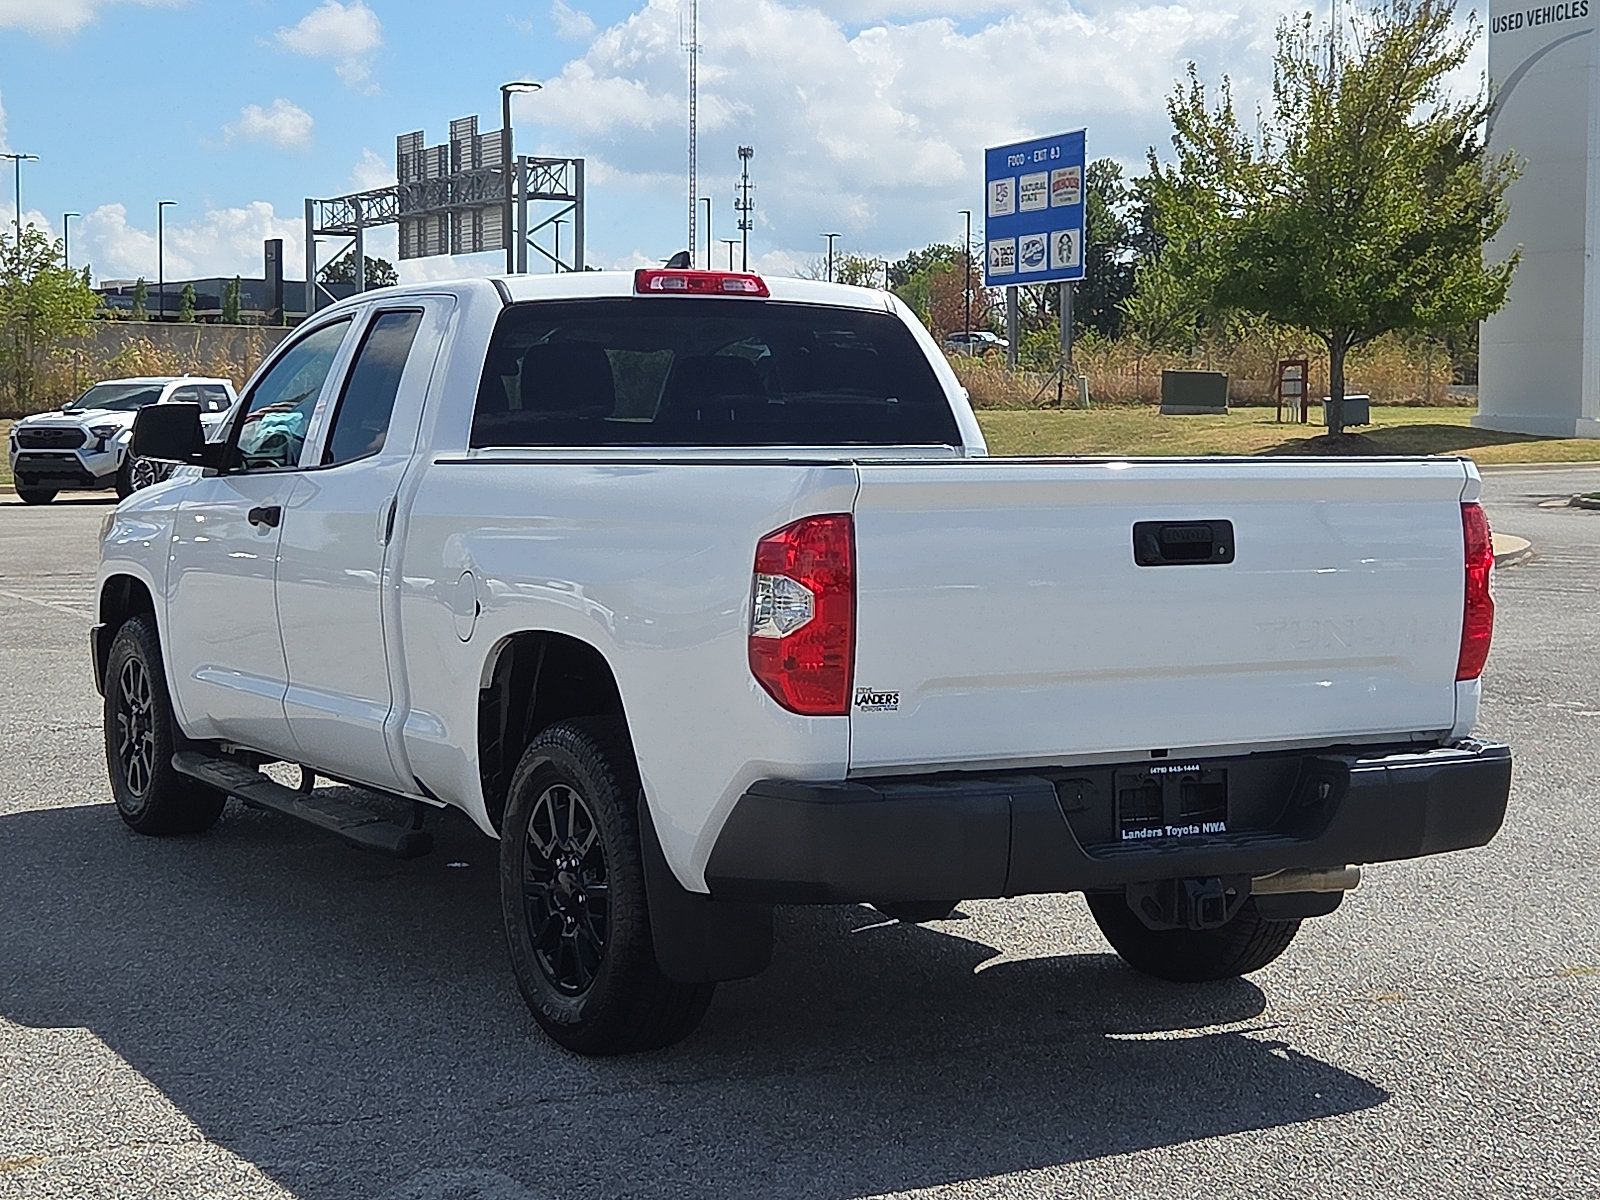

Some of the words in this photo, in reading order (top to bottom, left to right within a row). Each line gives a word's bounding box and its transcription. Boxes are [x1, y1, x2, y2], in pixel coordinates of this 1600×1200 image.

[1492, 12, 1523, 33] USED
[1526, 0, 1588, 27] VEHICLES
[1008, 153, 1025, 167] FOOD
[1033, 149, 1048, 162] EXIT
[1020, 182, 1047, 193] NATURAL
[1020, 193, 1038, 202] STATE
[1000, 246, 1015, 256] TACO
[1000, 256, 1015, 267] BELL
[855, 693, 899, 706] LANDERS
[1122, 828, 1162, 840] Landers
[1165, 825, 1200, 838] Toyota
[1202, 822, 1226, 833] NWA
